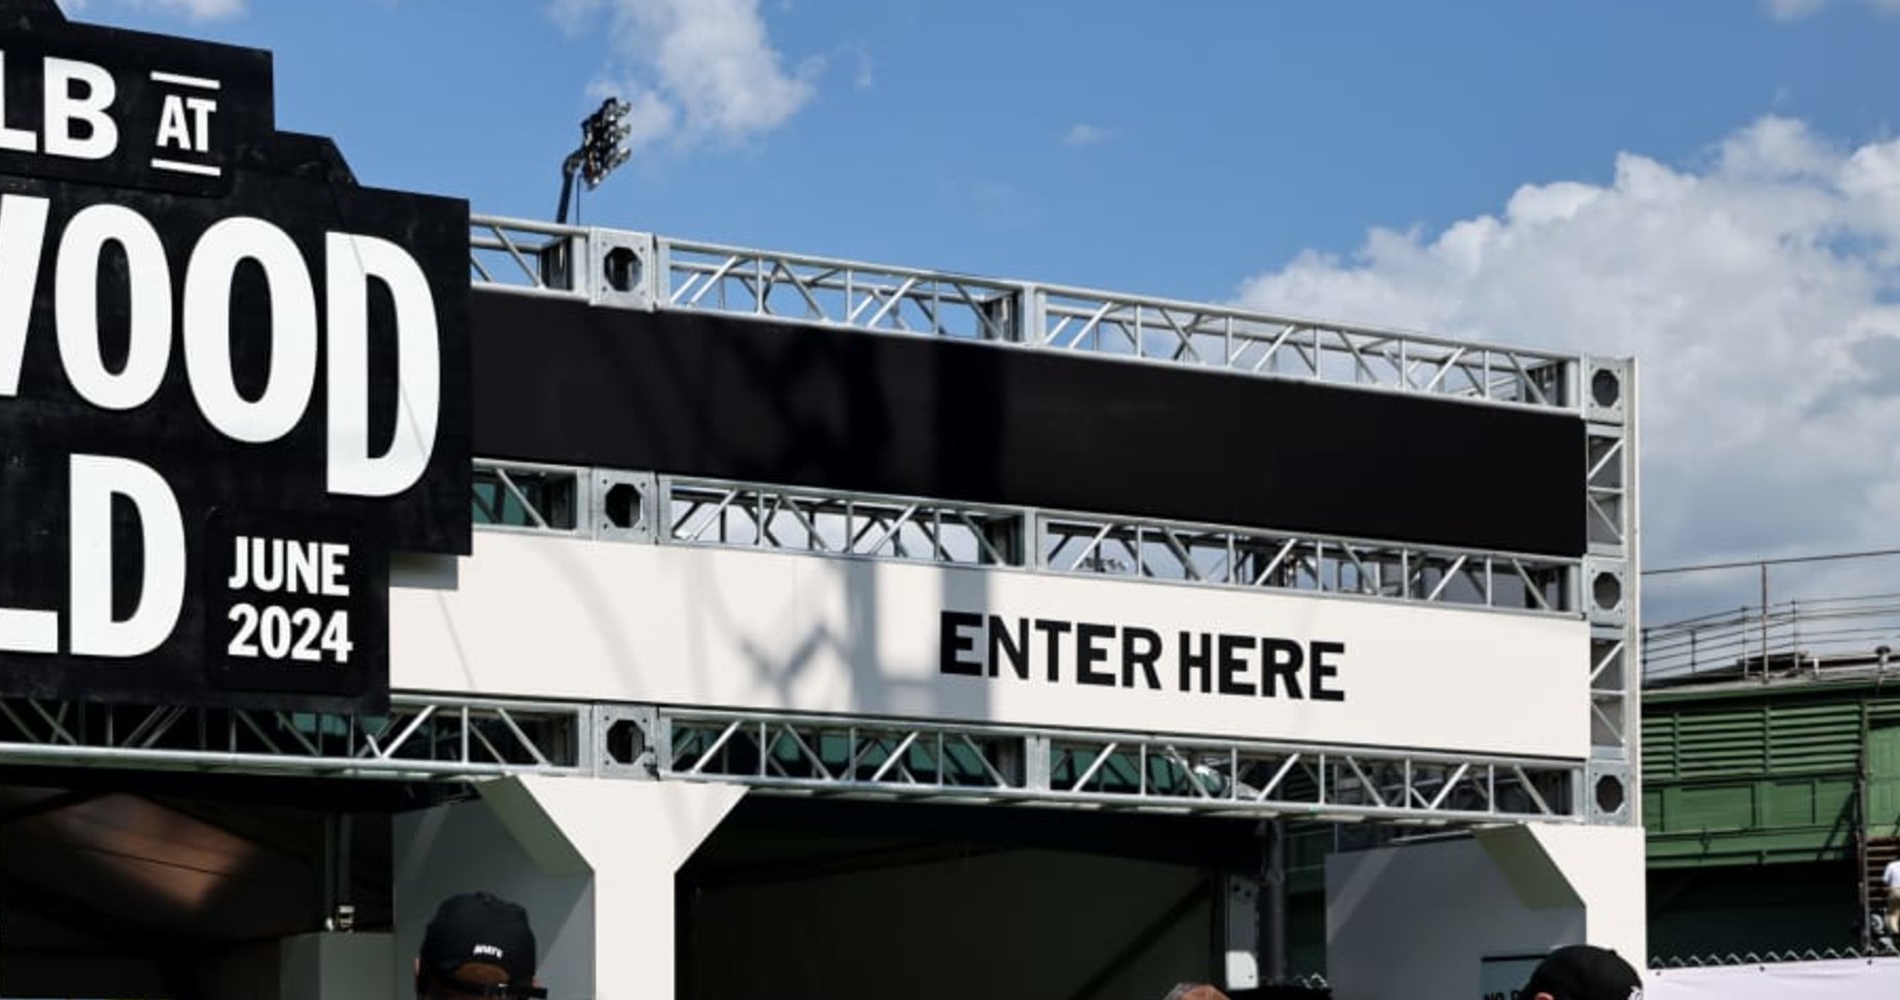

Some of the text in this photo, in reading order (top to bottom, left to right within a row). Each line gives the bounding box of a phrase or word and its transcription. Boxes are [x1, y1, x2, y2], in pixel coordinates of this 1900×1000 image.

[156, 94, 217, 153] AT
[227, 535, 350, 597] JUNE
[227, 602, 354, 663] 2024
[939, 610, 1346, 702] ENTER HERE
